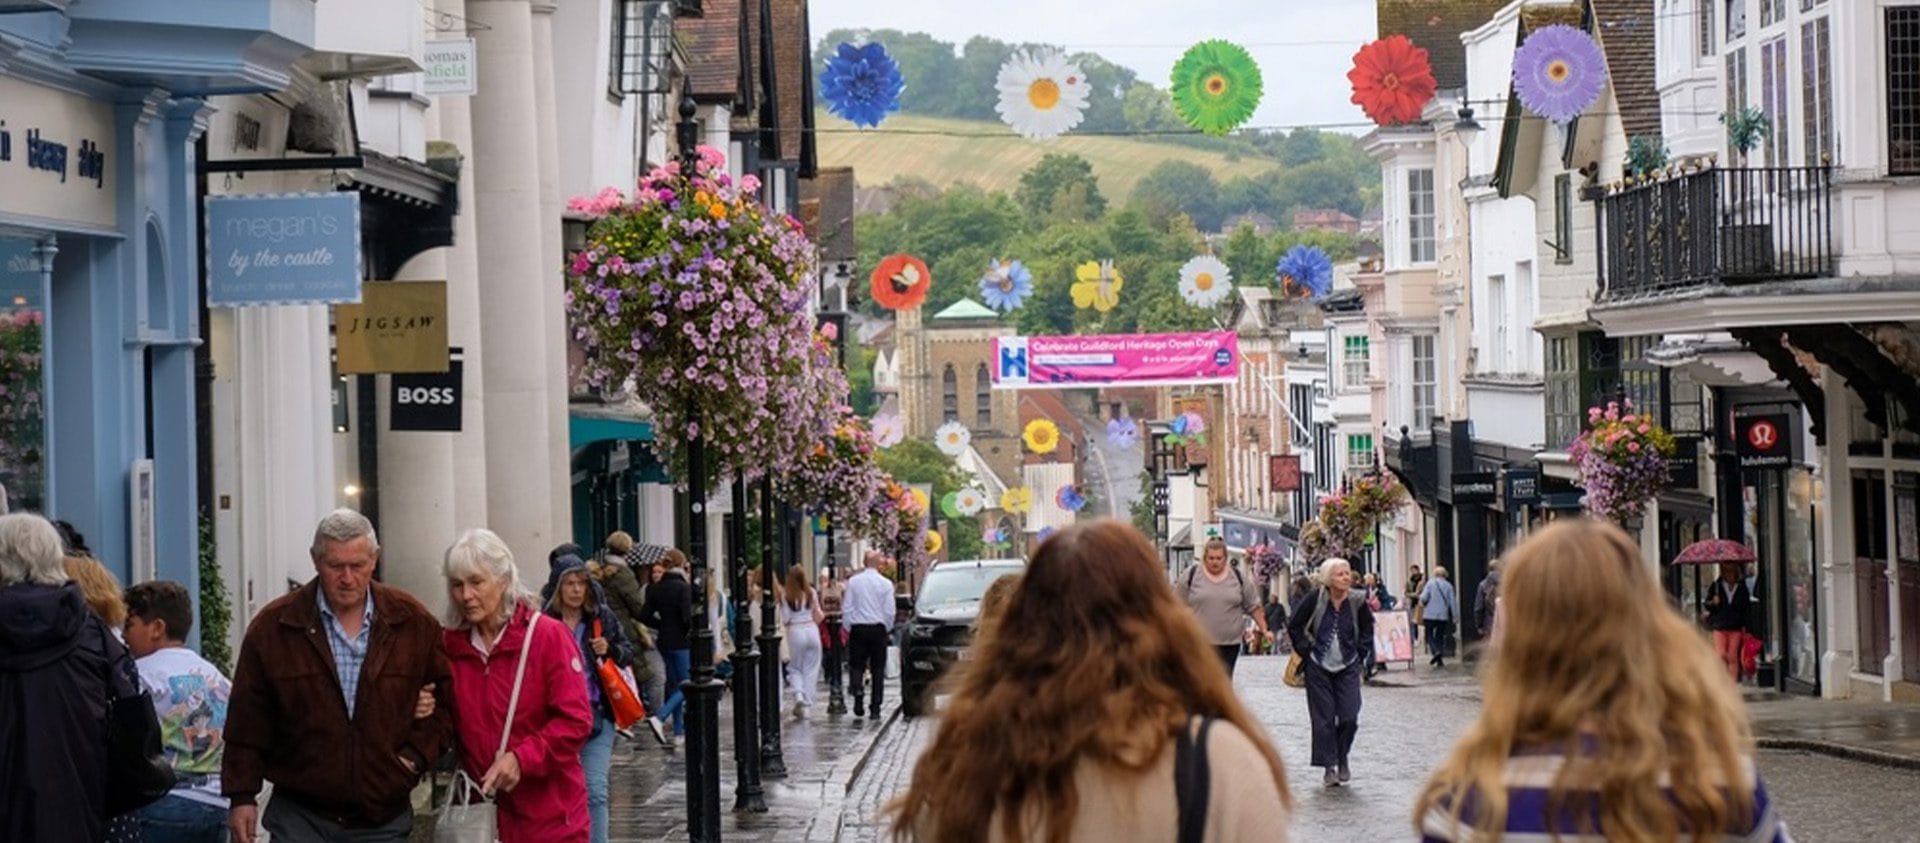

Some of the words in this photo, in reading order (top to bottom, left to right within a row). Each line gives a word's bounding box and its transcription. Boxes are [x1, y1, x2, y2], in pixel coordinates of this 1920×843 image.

[227, 206, 338, 243] megan's
[229, 249, 249, 278] by
[253, 248, 281, 267] the
[284, 247, 334, 267] castle
[350, 316, 434, 333] JIGSAW
[1032, 341, 1079, 352] Celebrate
[1080, 339, 1126, 352] Guildford
[1127, 339, 1167, 351] Heritage
[1168, 338, 1195, 350] Open
[1196, 338, 1219, 349] Days
[397, 386, 455, 405] BOSS
[1740, 455, 1788, 467] lululemon
